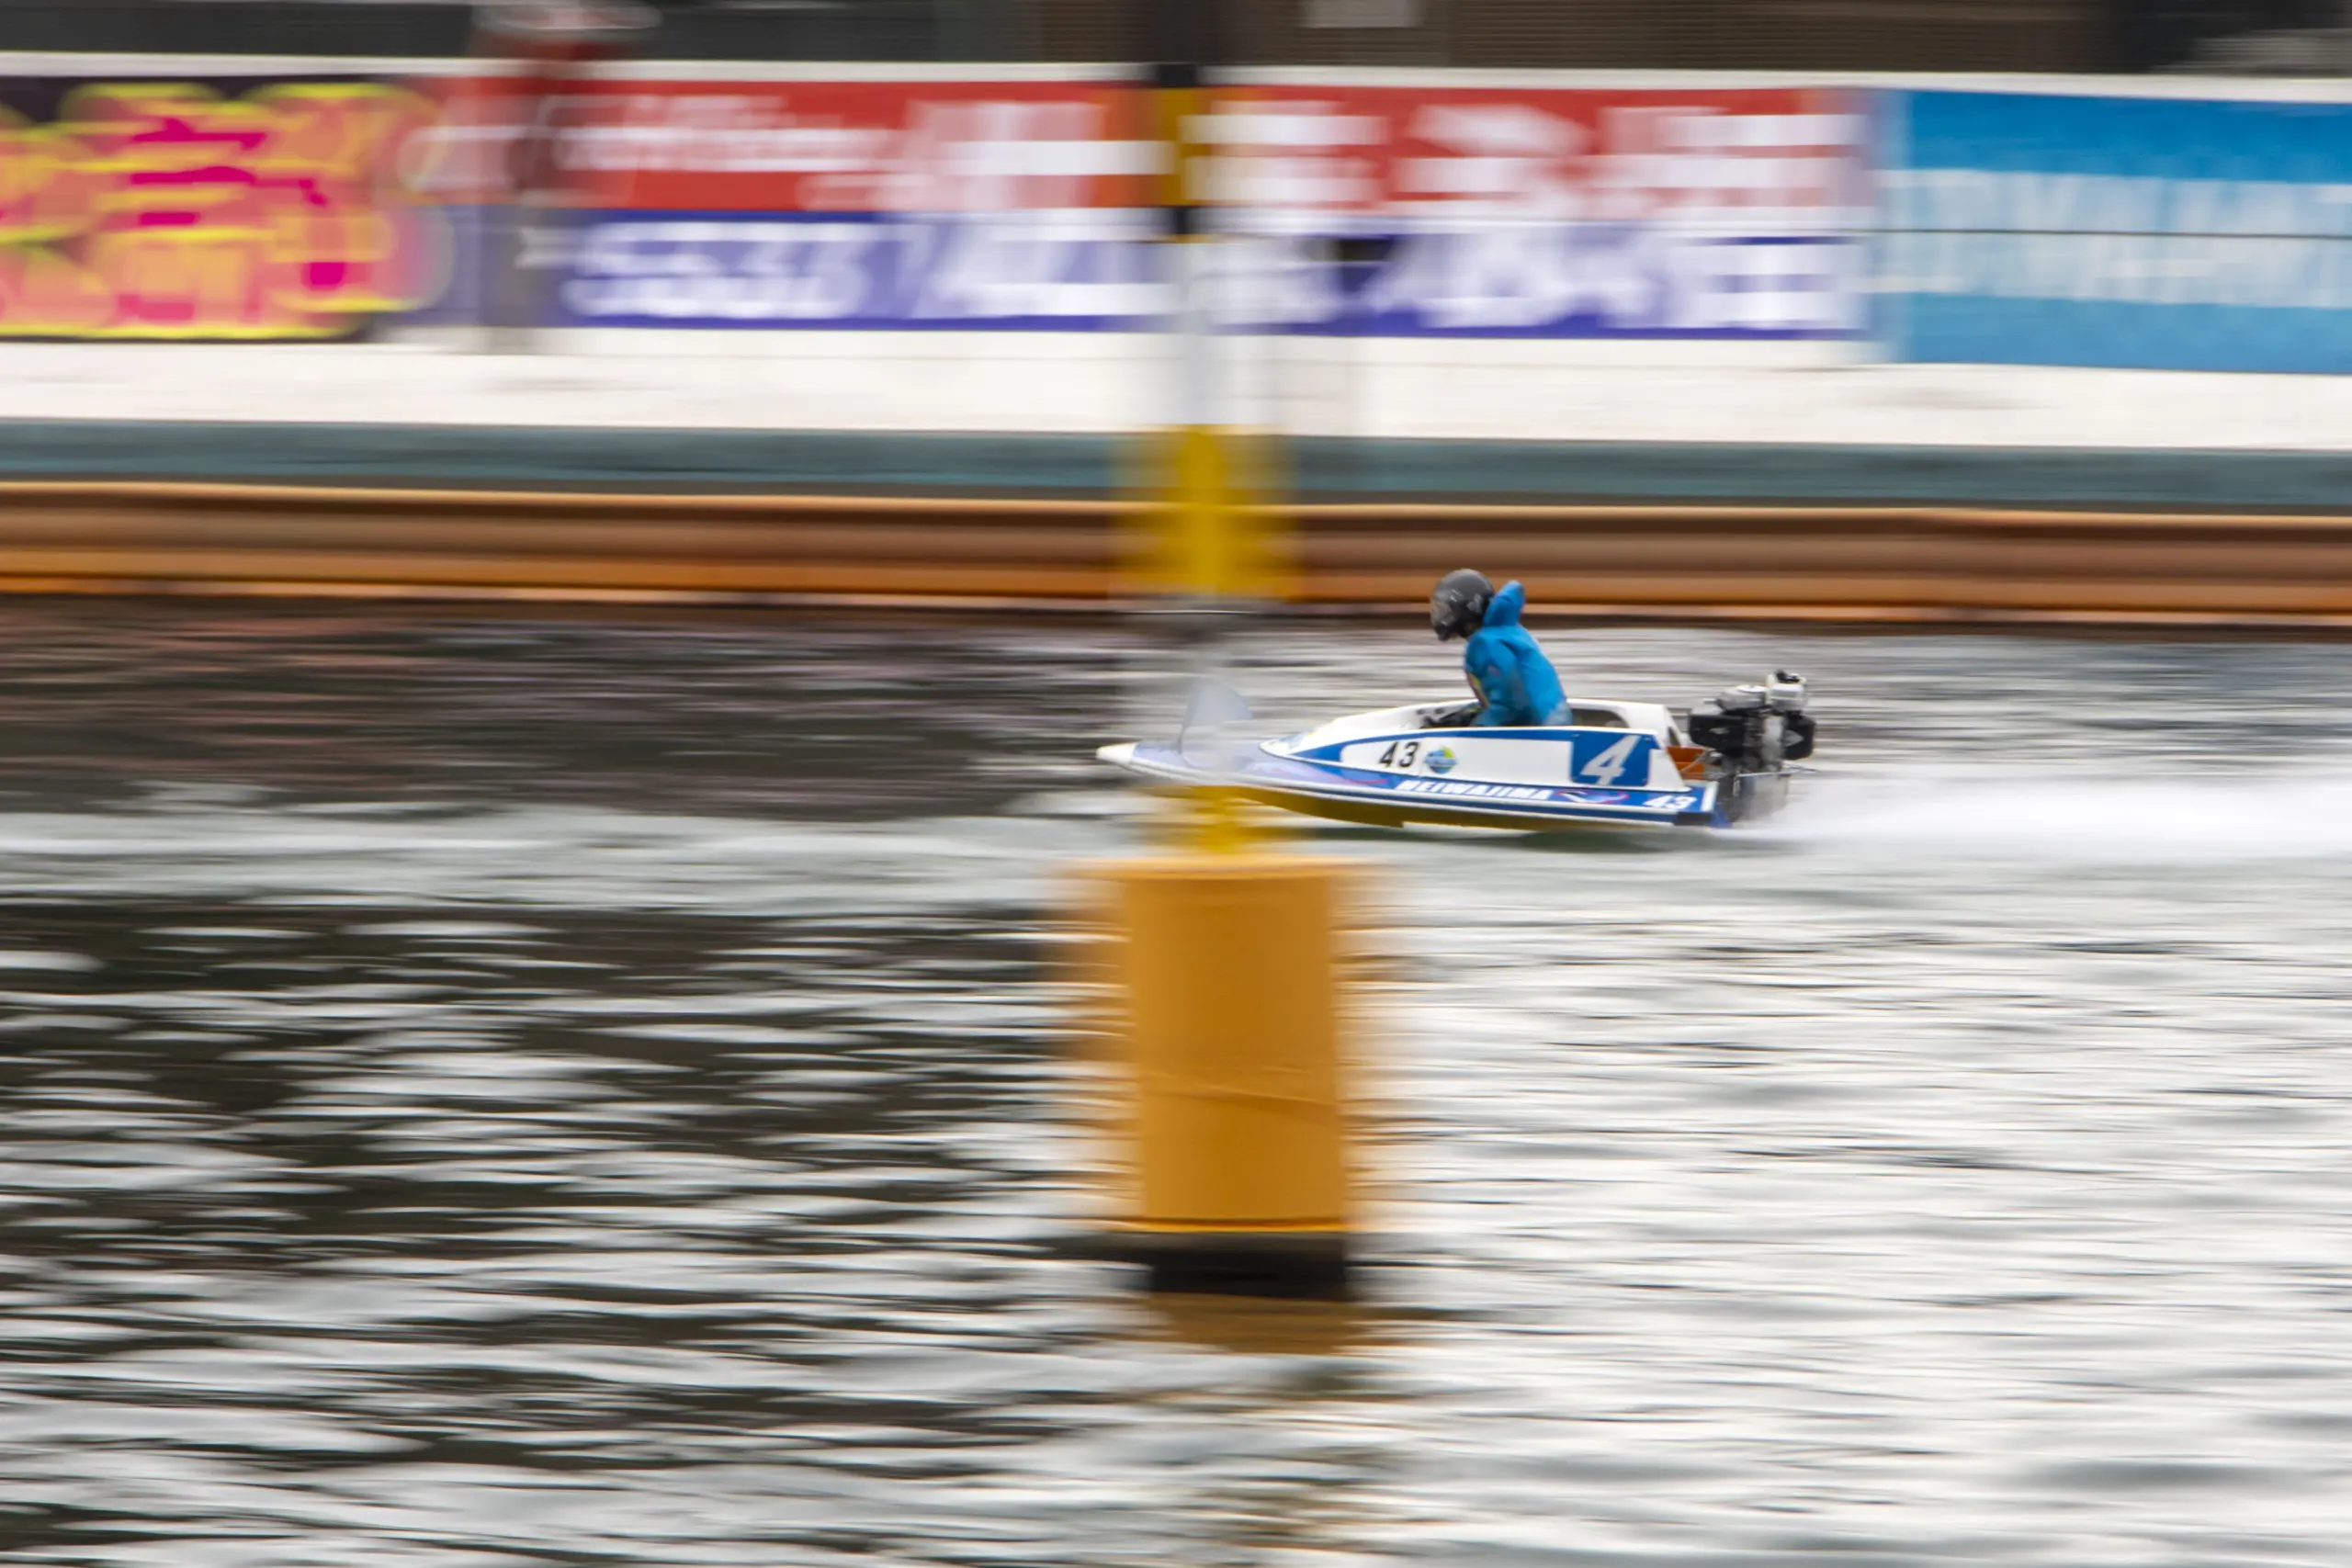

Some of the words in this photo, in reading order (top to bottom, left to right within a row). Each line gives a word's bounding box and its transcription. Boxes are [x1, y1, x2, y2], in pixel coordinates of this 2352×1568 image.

[1379, 741, 1419, 768] 43
[1580, 735, 1642, 786] 4
[1394, 780, 1555, 800] HEIWAJIMA
[1643, 795, 1698, 812] 43
